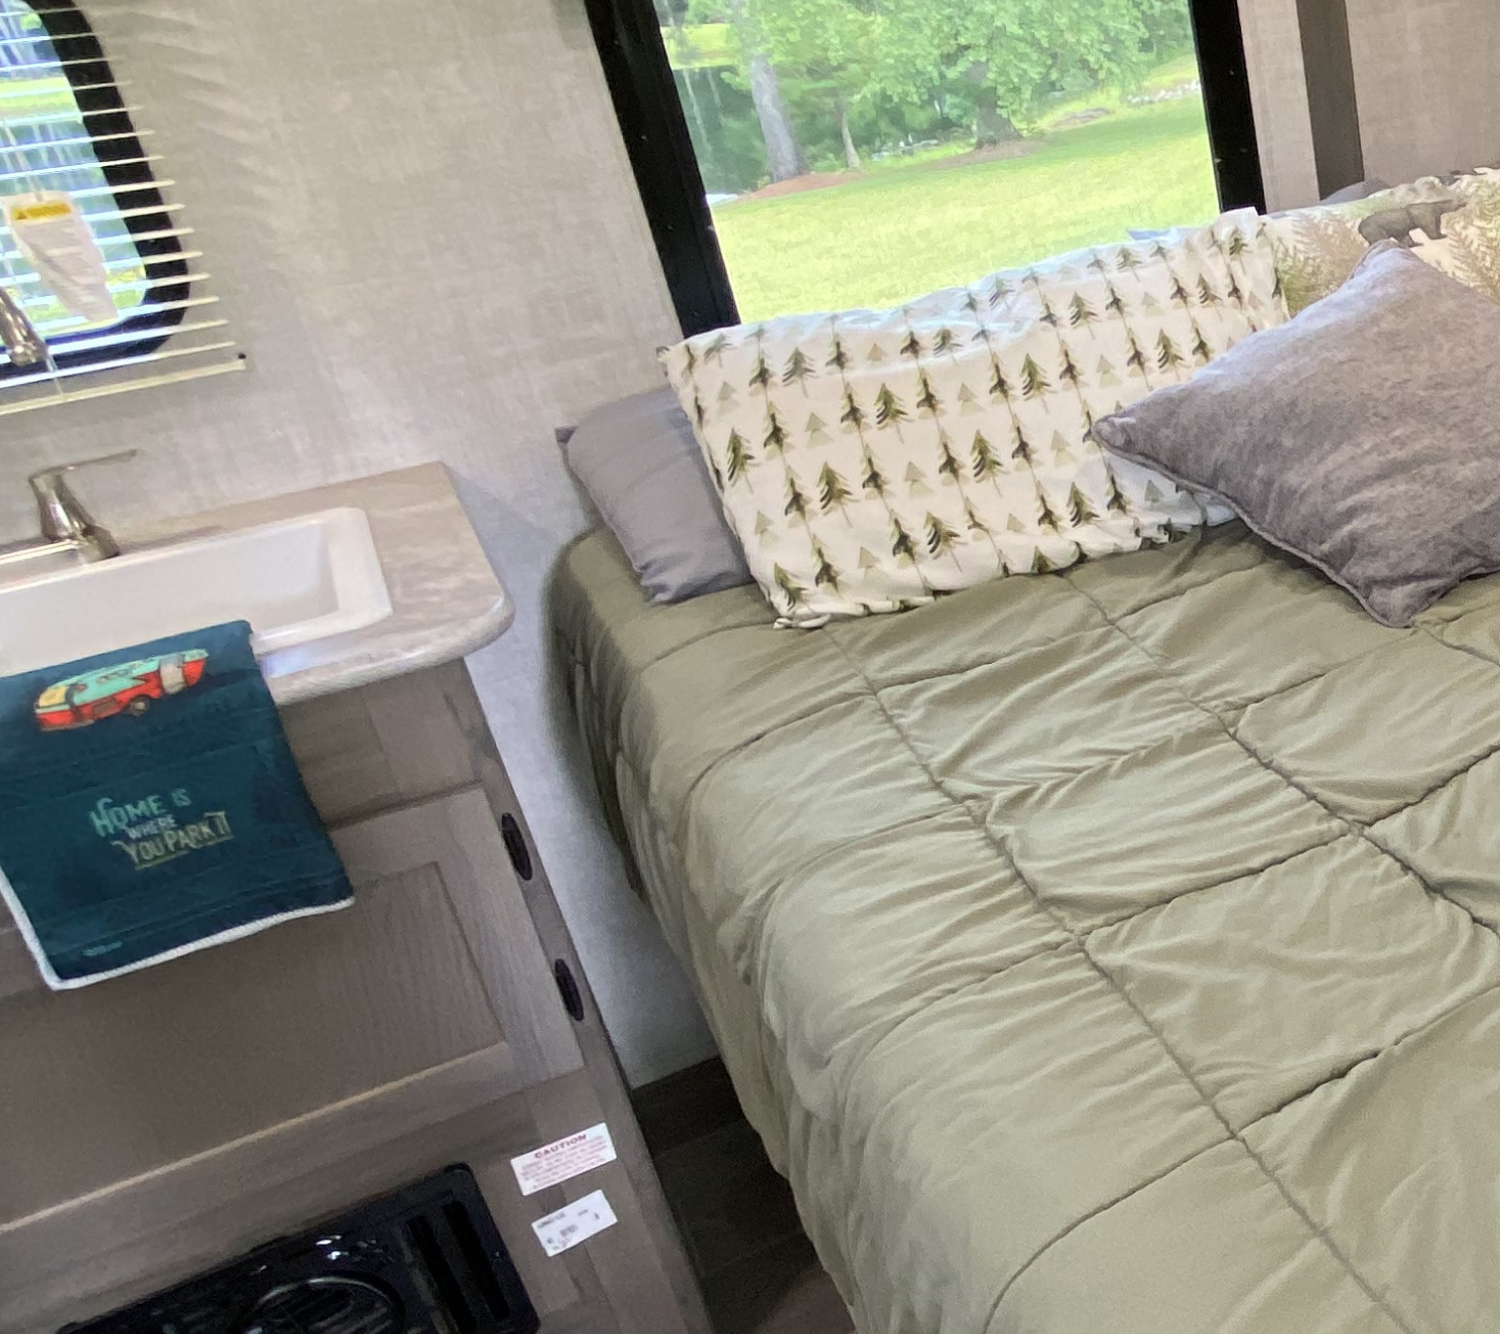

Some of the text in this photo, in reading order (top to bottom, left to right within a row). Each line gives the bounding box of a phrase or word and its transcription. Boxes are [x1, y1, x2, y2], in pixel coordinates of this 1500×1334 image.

[171, 788, 191, 807] IS
[124, 814, 178, 840] WHERE
[110, 840, 166, 865] YOU
[164, 823, 216, 850] PARK
[534, 1133, 587, 1159] CAUTION
